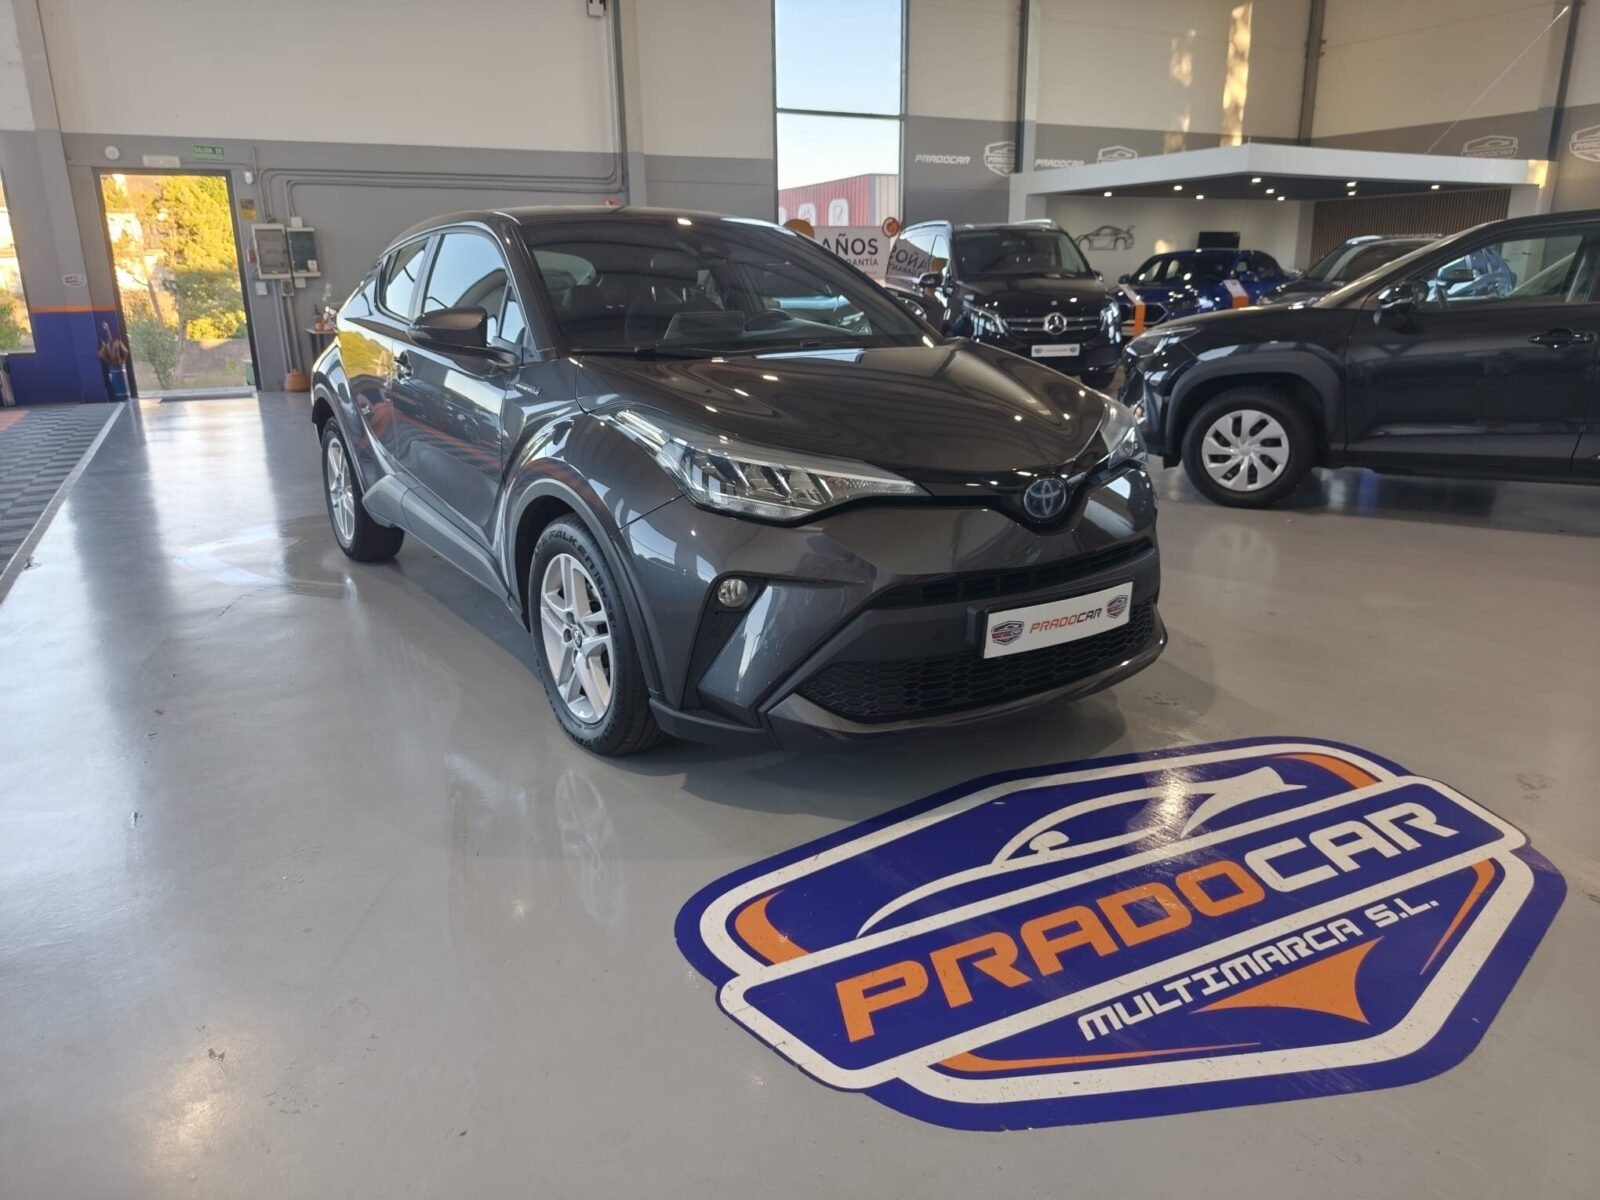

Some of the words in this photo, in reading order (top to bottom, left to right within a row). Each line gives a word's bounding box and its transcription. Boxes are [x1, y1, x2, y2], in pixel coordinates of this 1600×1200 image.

[914, 154, 971, 165] PRADOCAR
[846, 257, 879, 266] RANTÍA
[1029, 608, 1103, 634] PRADOCAR
[834, 801, 1460, 1043] PRADOCAR
[1076, 918, 1364, 1042] MULTIMARCA
[1373, 897, 1440, 929] S.L.
